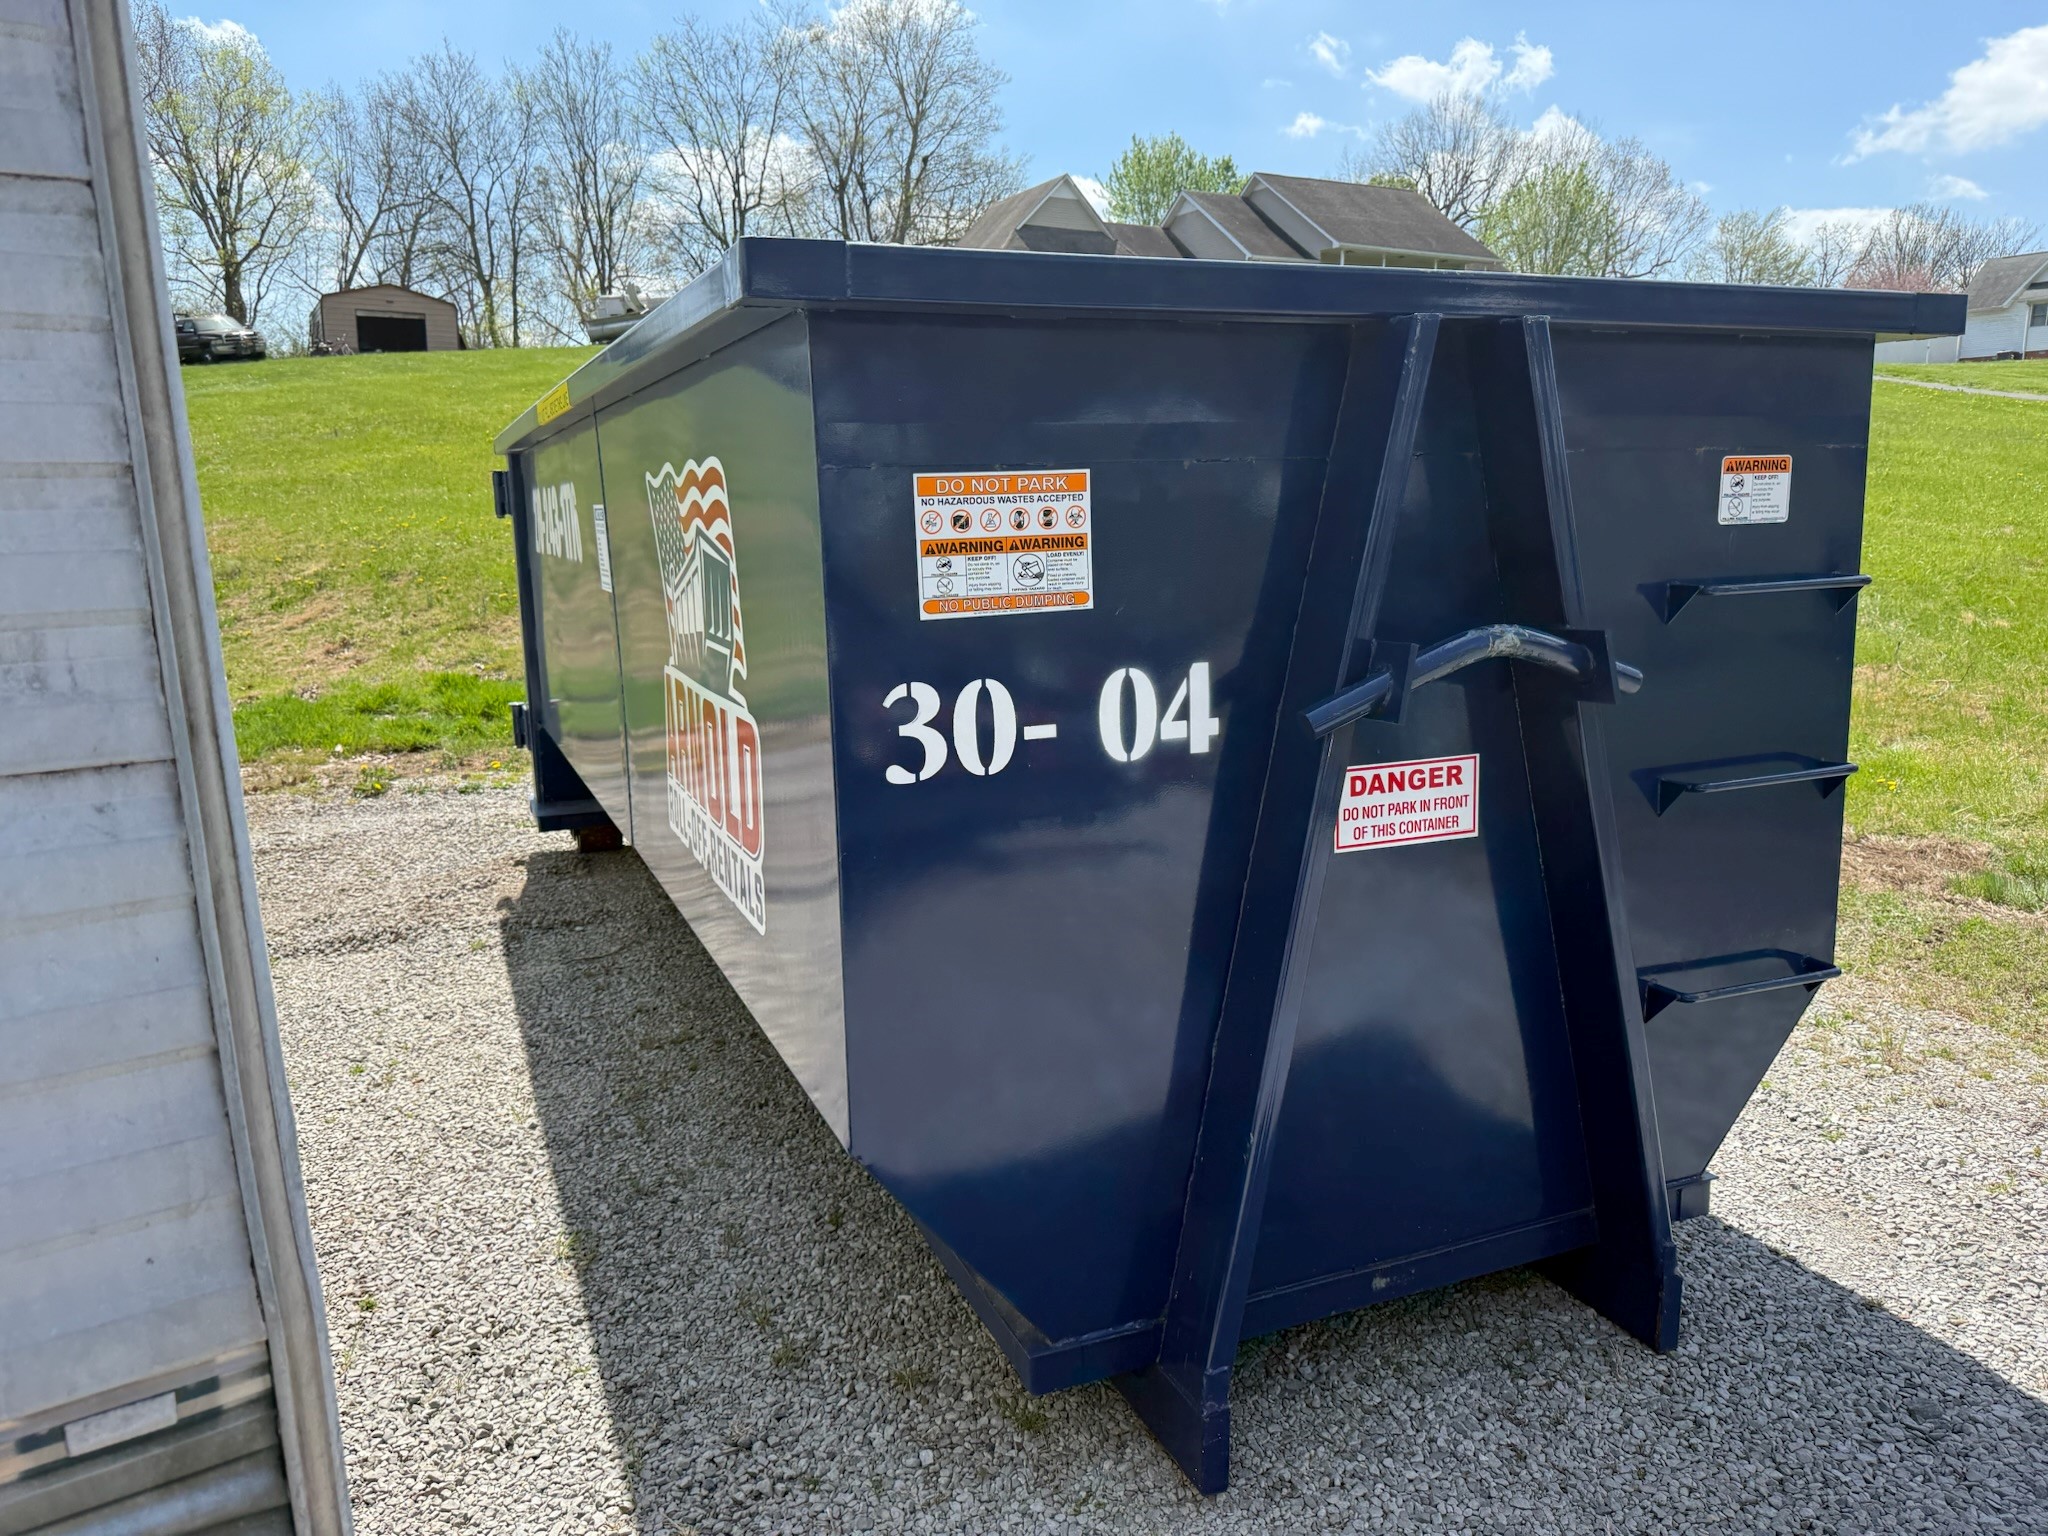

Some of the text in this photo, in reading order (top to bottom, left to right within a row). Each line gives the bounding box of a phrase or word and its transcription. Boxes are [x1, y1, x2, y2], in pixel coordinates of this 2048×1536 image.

[1735, 460, 1787, 471] WARNING
[936, 475, 1068, 494] DO NOT PARK
[921, 493, 1084, 506] NO HAZARDOUS WASTES ACCEPTED
[936, 540, 1004, 554] WARNING
[1020, 536, 1084, 550] WARNING
[939, 600, 959, 612] NO
[963, 597, 1012, 610] PUBLIC
[1016, 593, 1075, 608] DUMPING
[882, 662, 1220, 785] 30- 04
[665, 671, 763, 857] ARNOLD
[1350, 765, 1463, 798] DANGER
[1343, 794, 1470, 822] DO NOT PARK IN FRONT
[1353, 816, 1459, 840] OF THIS CONTAINER
[710, 830, 764, 926] RENTALS
